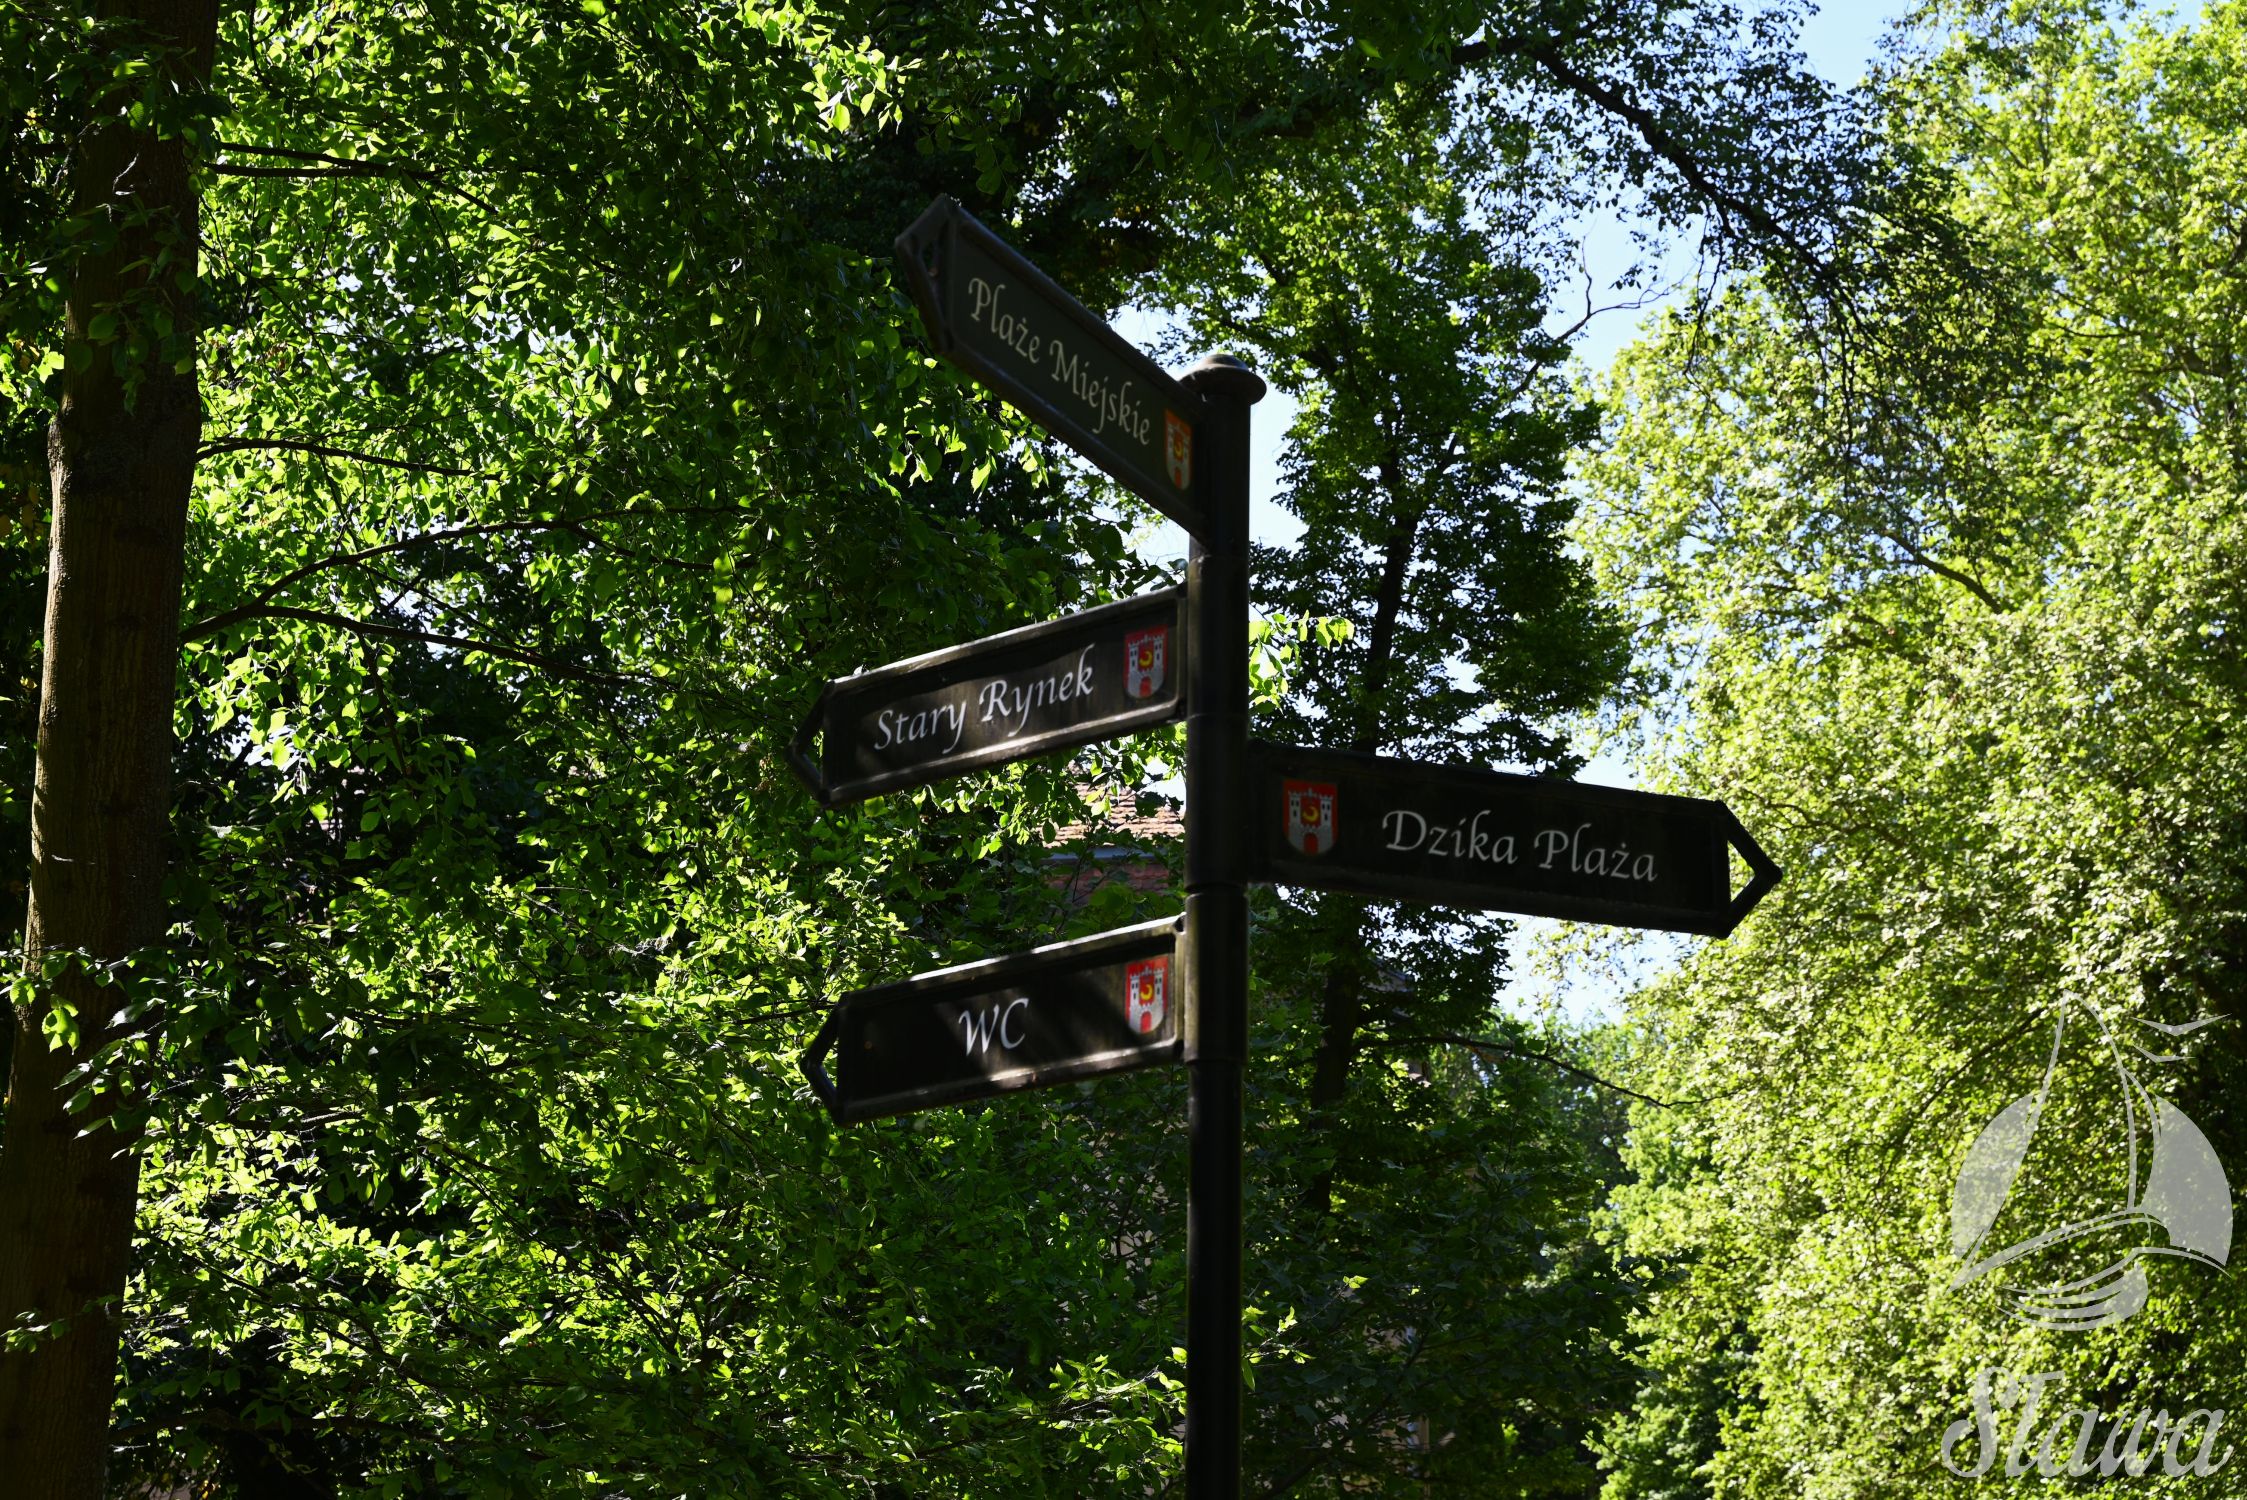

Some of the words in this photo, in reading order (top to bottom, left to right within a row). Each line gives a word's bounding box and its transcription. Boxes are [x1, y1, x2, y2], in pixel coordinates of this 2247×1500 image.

[968, 278, 1040, 364] Plaże
[1050, 340, 1150, 446] Miejskie
[873, 697, 967, 755] Stary
[979, 643, 1095, 738] Rynek
[1382, 810, 1518, 865] Dzika
[1534, 823, 1658, 883] Plaża
[959, 997, 1030, 1056] WC
